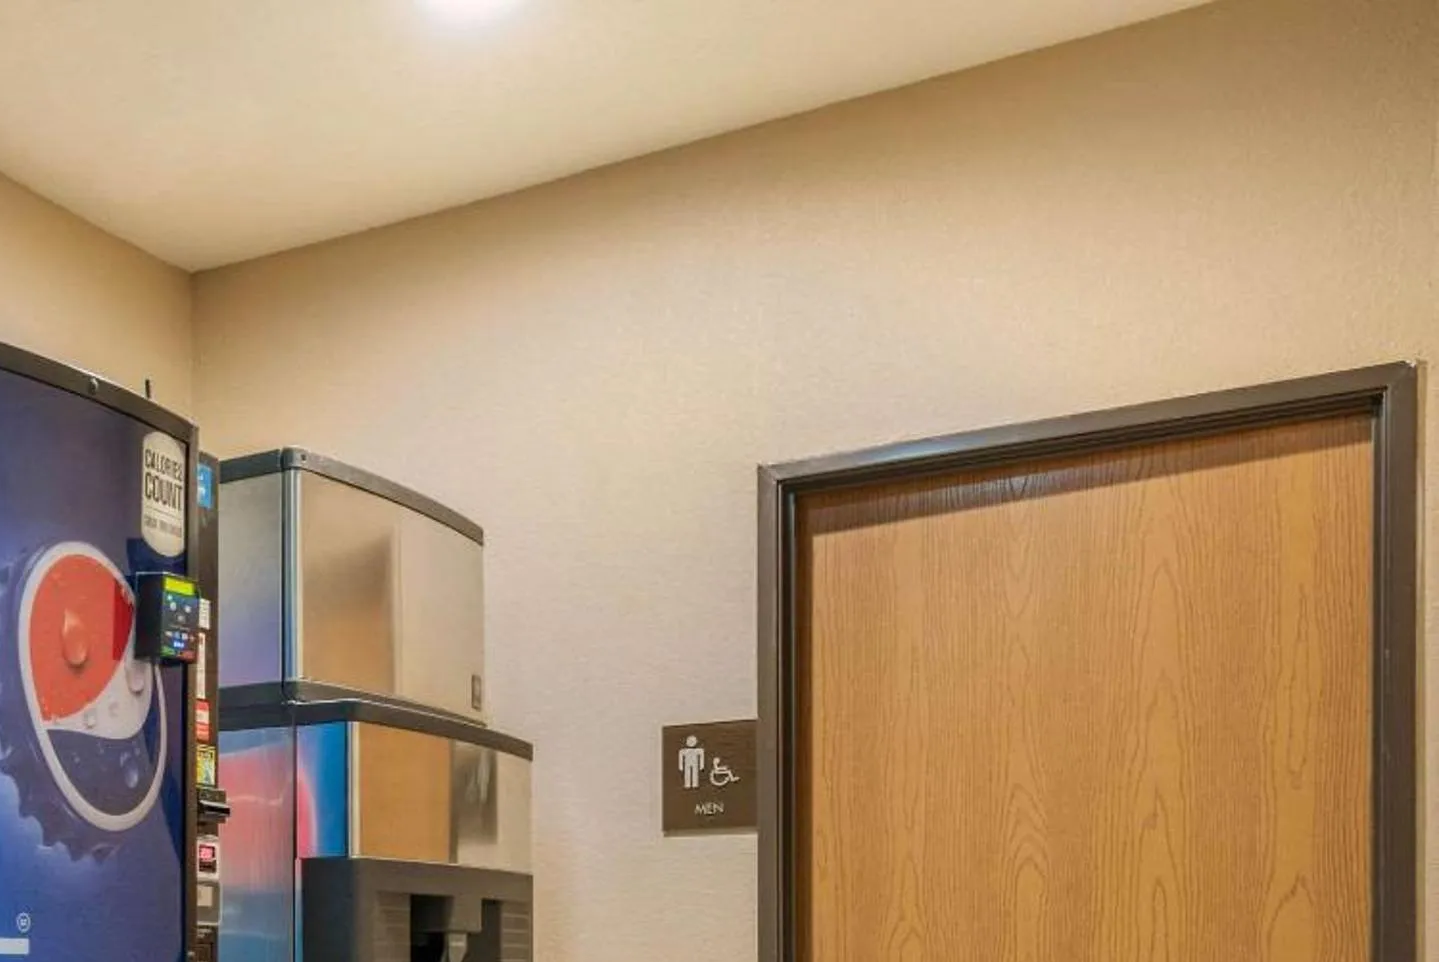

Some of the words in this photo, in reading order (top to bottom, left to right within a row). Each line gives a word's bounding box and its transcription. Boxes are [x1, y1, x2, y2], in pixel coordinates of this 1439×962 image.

[145, 448, 182, 482] CALORIES
[145, 471, 182, 512] COUNT
[694, 801, 724, 815] MEN
